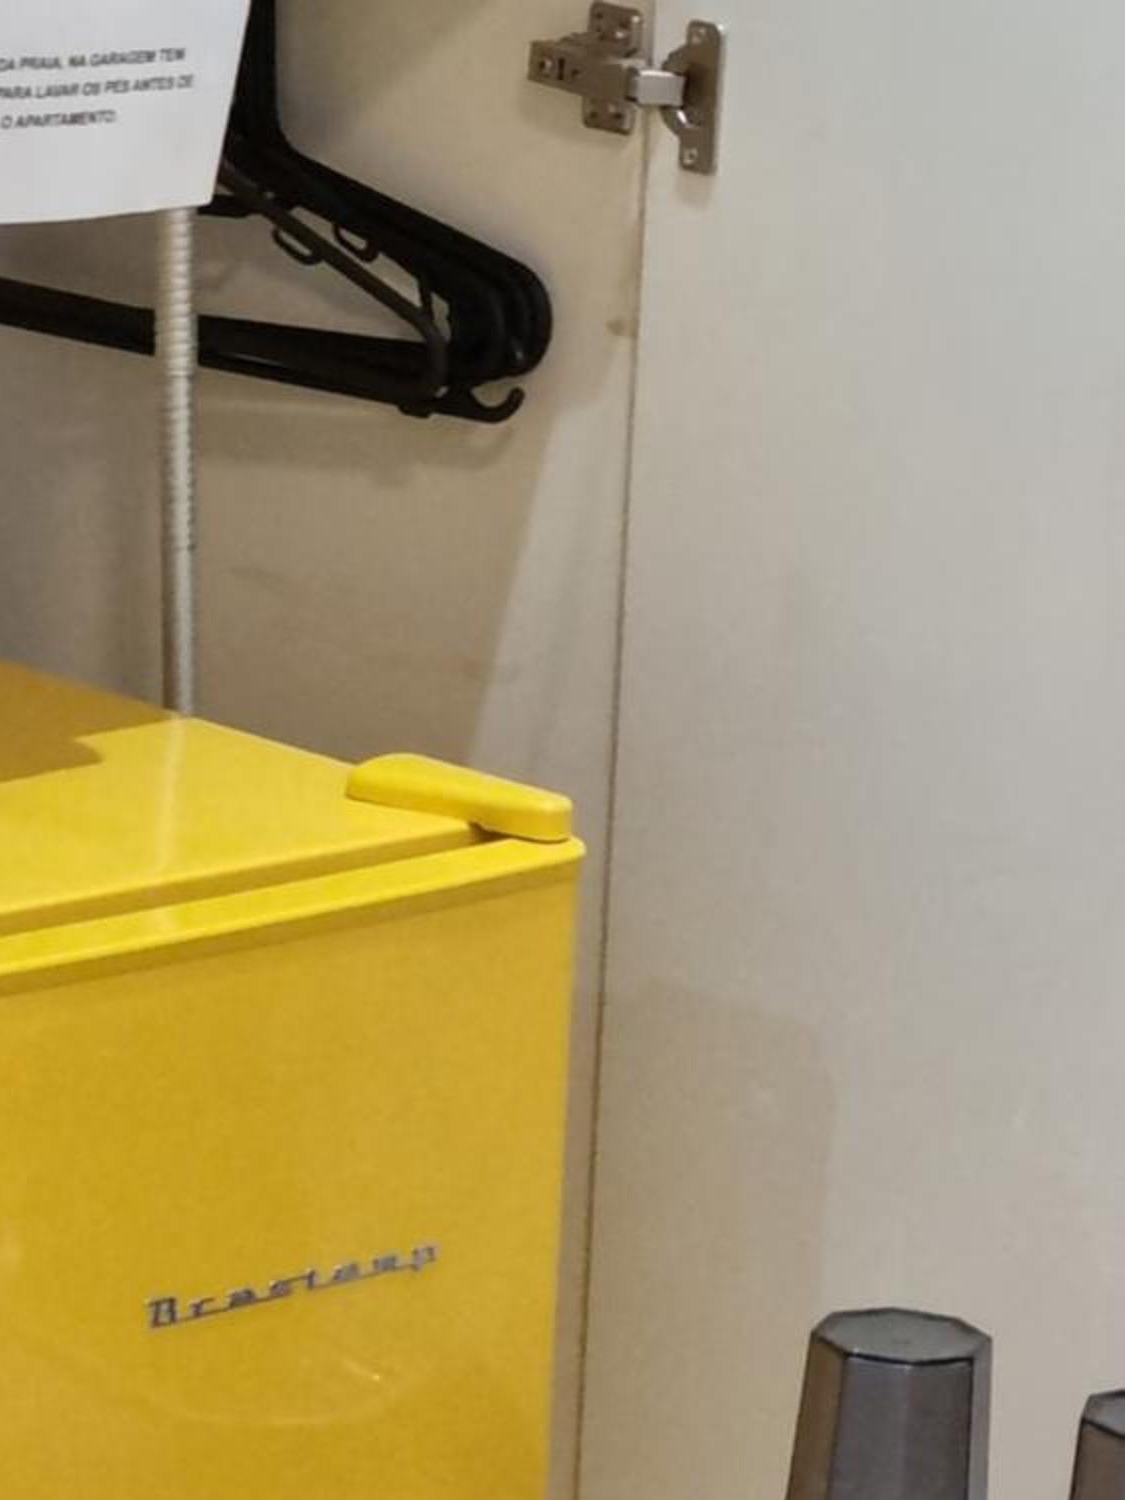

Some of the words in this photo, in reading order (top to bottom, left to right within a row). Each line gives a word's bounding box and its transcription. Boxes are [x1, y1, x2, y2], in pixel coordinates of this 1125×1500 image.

[68, 53, 87, 67] NA
[90, 48, 156, 67] GARAGEM
[159, 47, 187, 62] TEM
[34, 82, 79, 99] LAVAR
[82, 81, 101, 97] OS
[132, 76, 175, 92] ANTES
[176, 73, 195, 89] DE
[0, 114, 13, 129] O
[147, 1245, 439, 1329] Brastemp
